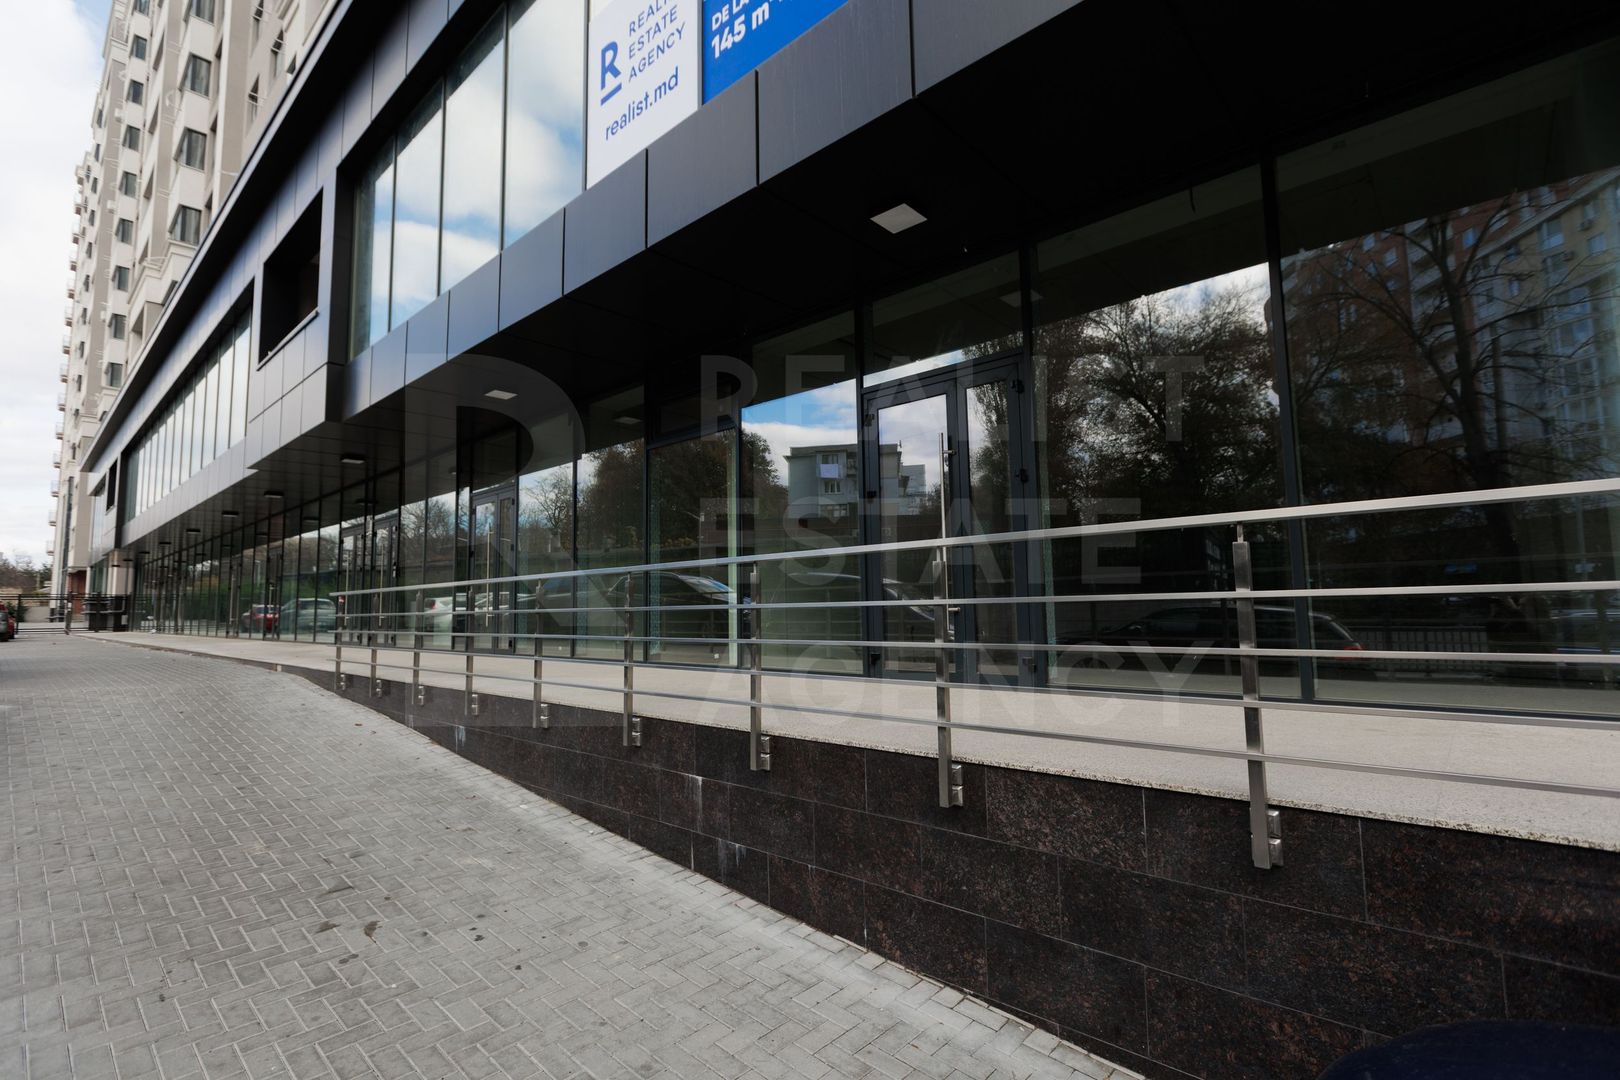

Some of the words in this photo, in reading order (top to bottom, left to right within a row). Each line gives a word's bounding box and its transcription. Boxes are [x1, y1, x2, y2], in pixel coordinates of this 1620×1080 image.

[629, 4, 678, 60] ESTATE
[711, 4, 730, 31] DE
[711, 14, 746, 59] 145
[600, 41, 622, 91] R
[628, 21, 686, 83] AGENCY
[606, 66, 679, 140] realist.md
